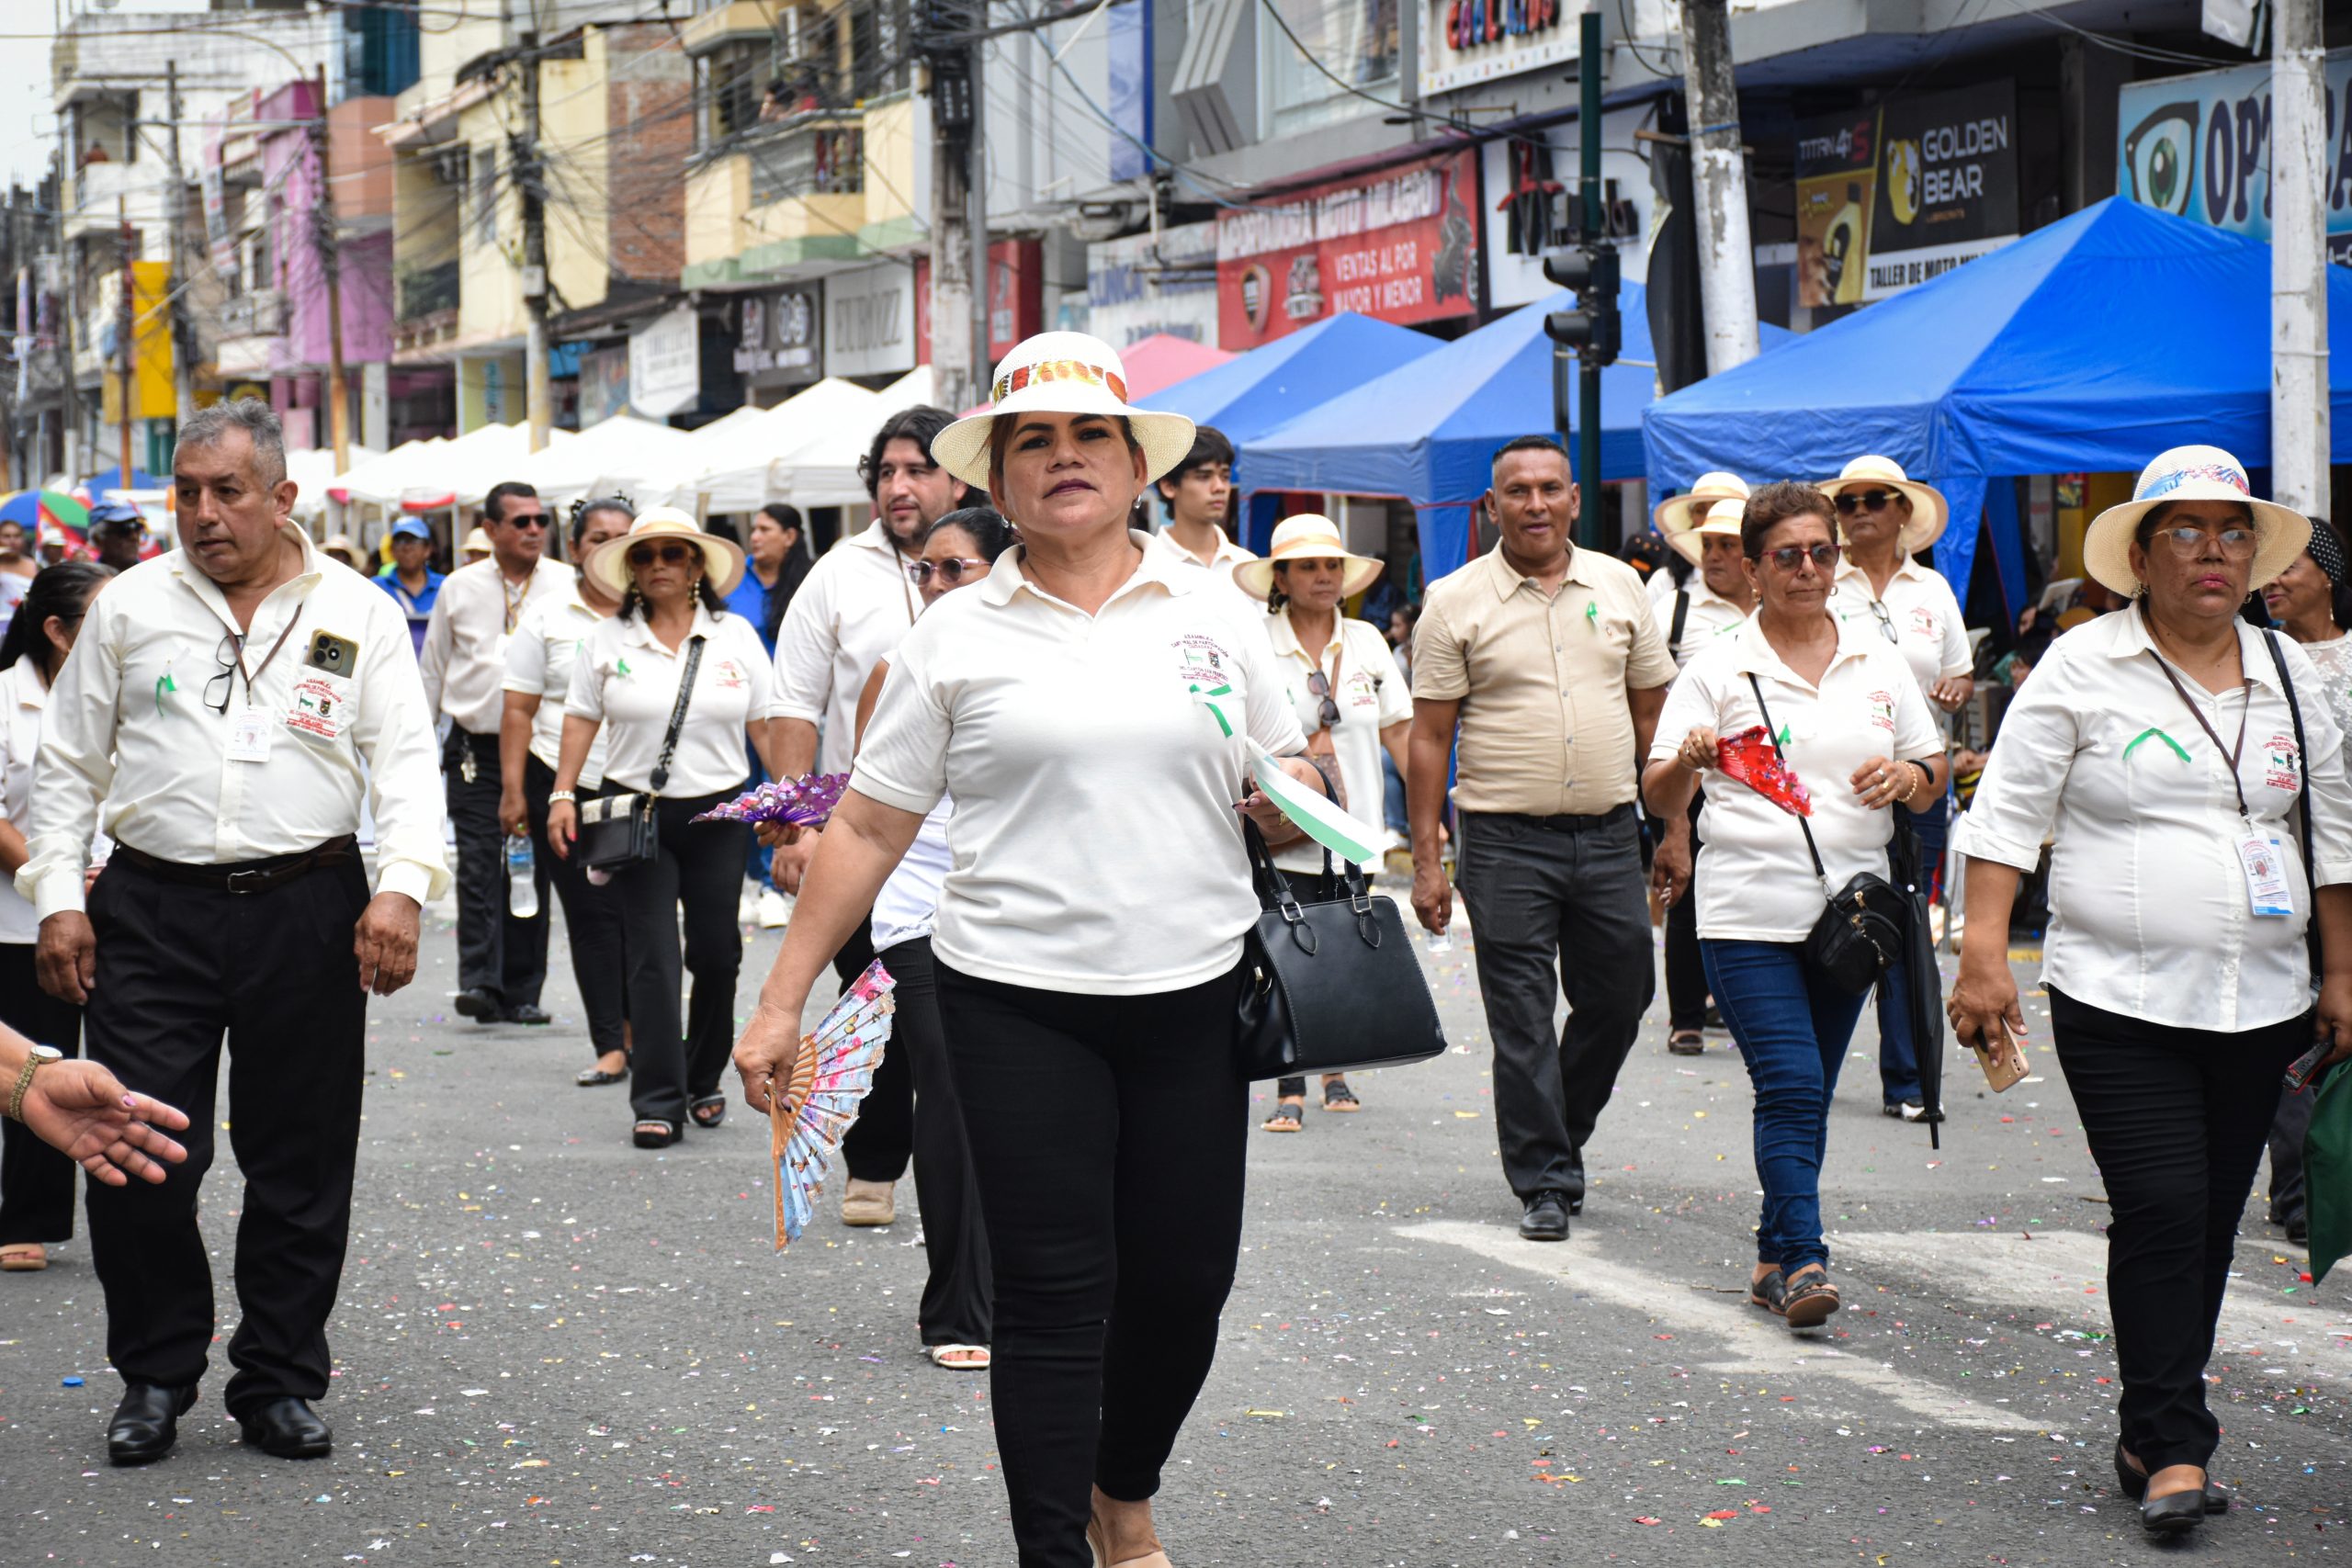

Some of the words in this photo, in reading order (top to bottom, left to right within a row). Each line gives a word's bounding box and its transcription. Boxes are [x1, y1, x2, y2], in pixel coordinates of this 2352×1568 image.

[1922, 116, 2008, 163] GOLDEN
[1317, 187, 1362, 241] MOTO
[1366, 169, 1434, 231] MILAGRO
[1923, 164, 1984, 206] BEAR
[1333, 249, 1378, 281] VENTAS
[1380, 245, 1394, 275] AL
[1395, 241, 1418, 270] POR
[1871, 263, 1906, 290] TALLER
[1908, 261, 1923, 285] DE
[1332, 286, 1373, 314] MAYOR
[1374, 283, 1383, 310] Y
[1383, 276, 1423, 309] MENOR
